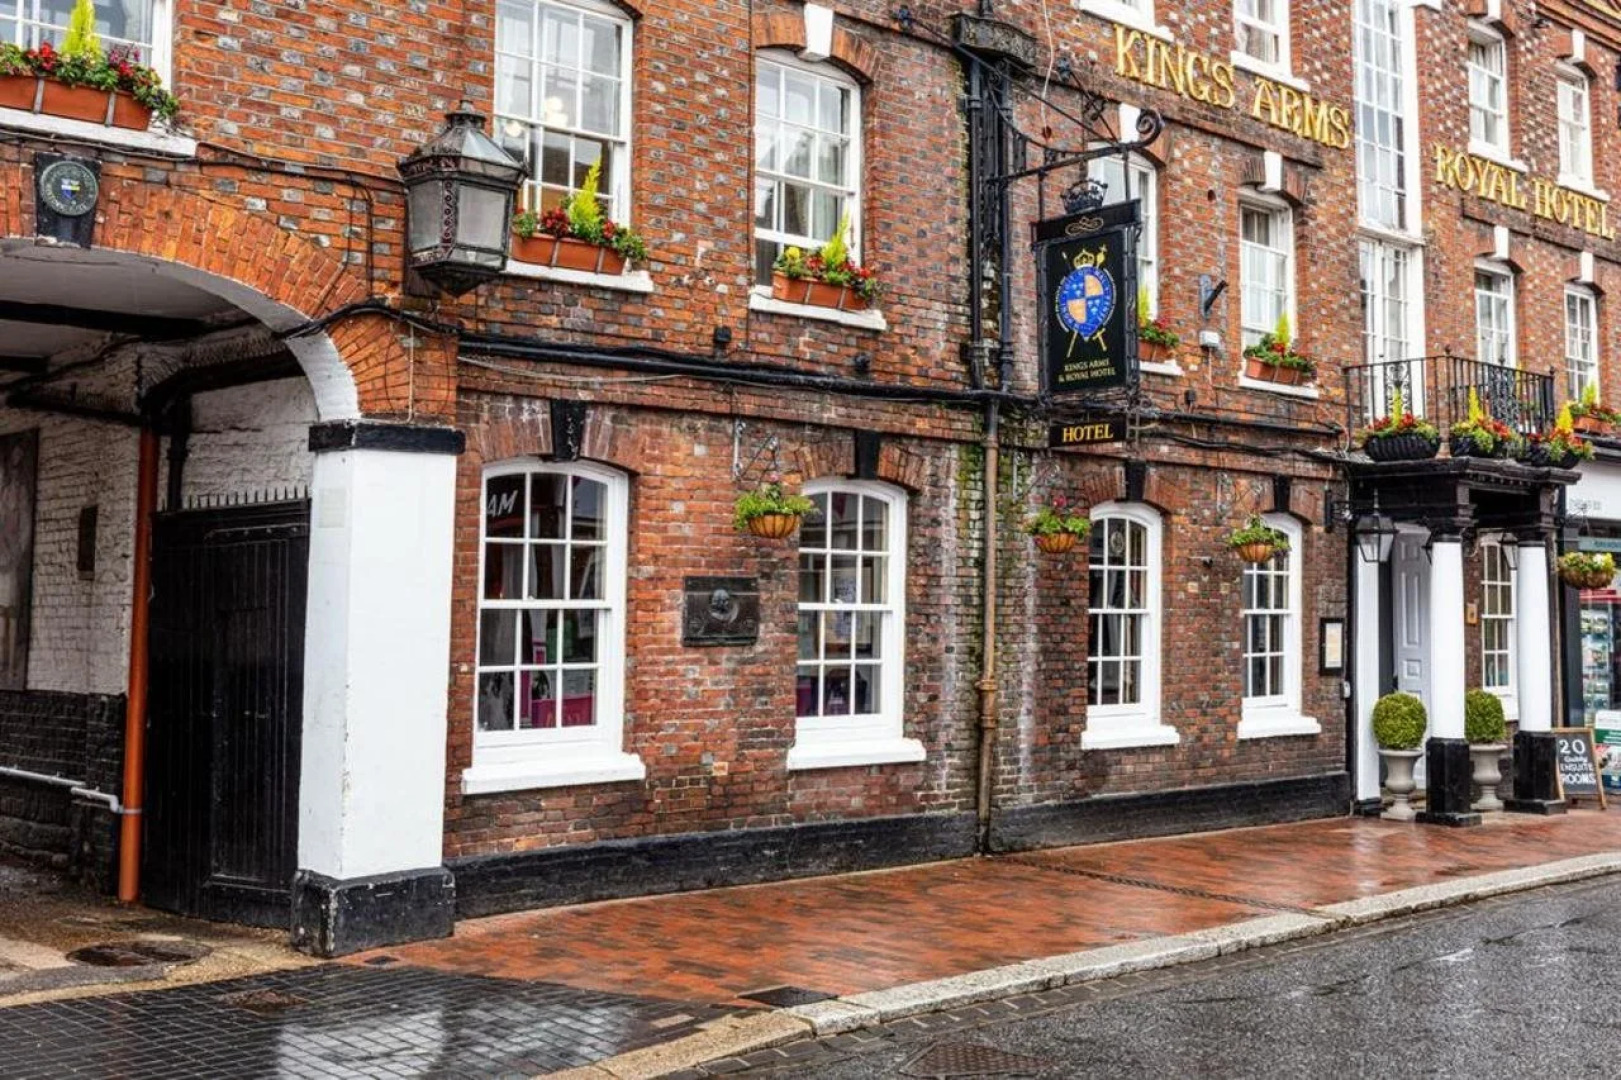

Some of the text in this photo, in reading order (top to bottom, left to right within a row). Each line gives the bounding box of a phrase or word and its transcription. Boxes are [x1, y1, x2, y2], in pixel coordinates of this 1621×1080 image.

[1113, 23, 1350, 149] KINGS ARMS
[1433, 142, 1616, 242] ROYAL HOTEL
[1064, 358, 1110, 372] KINGS ARMS
[1065, 371, 1089, 382] ROYAL
[1089, 366, 1116, 378] HOTEL
[1063, 422, 1114, 443] HOTEL
[1558, 738, 1586, 755] 20
